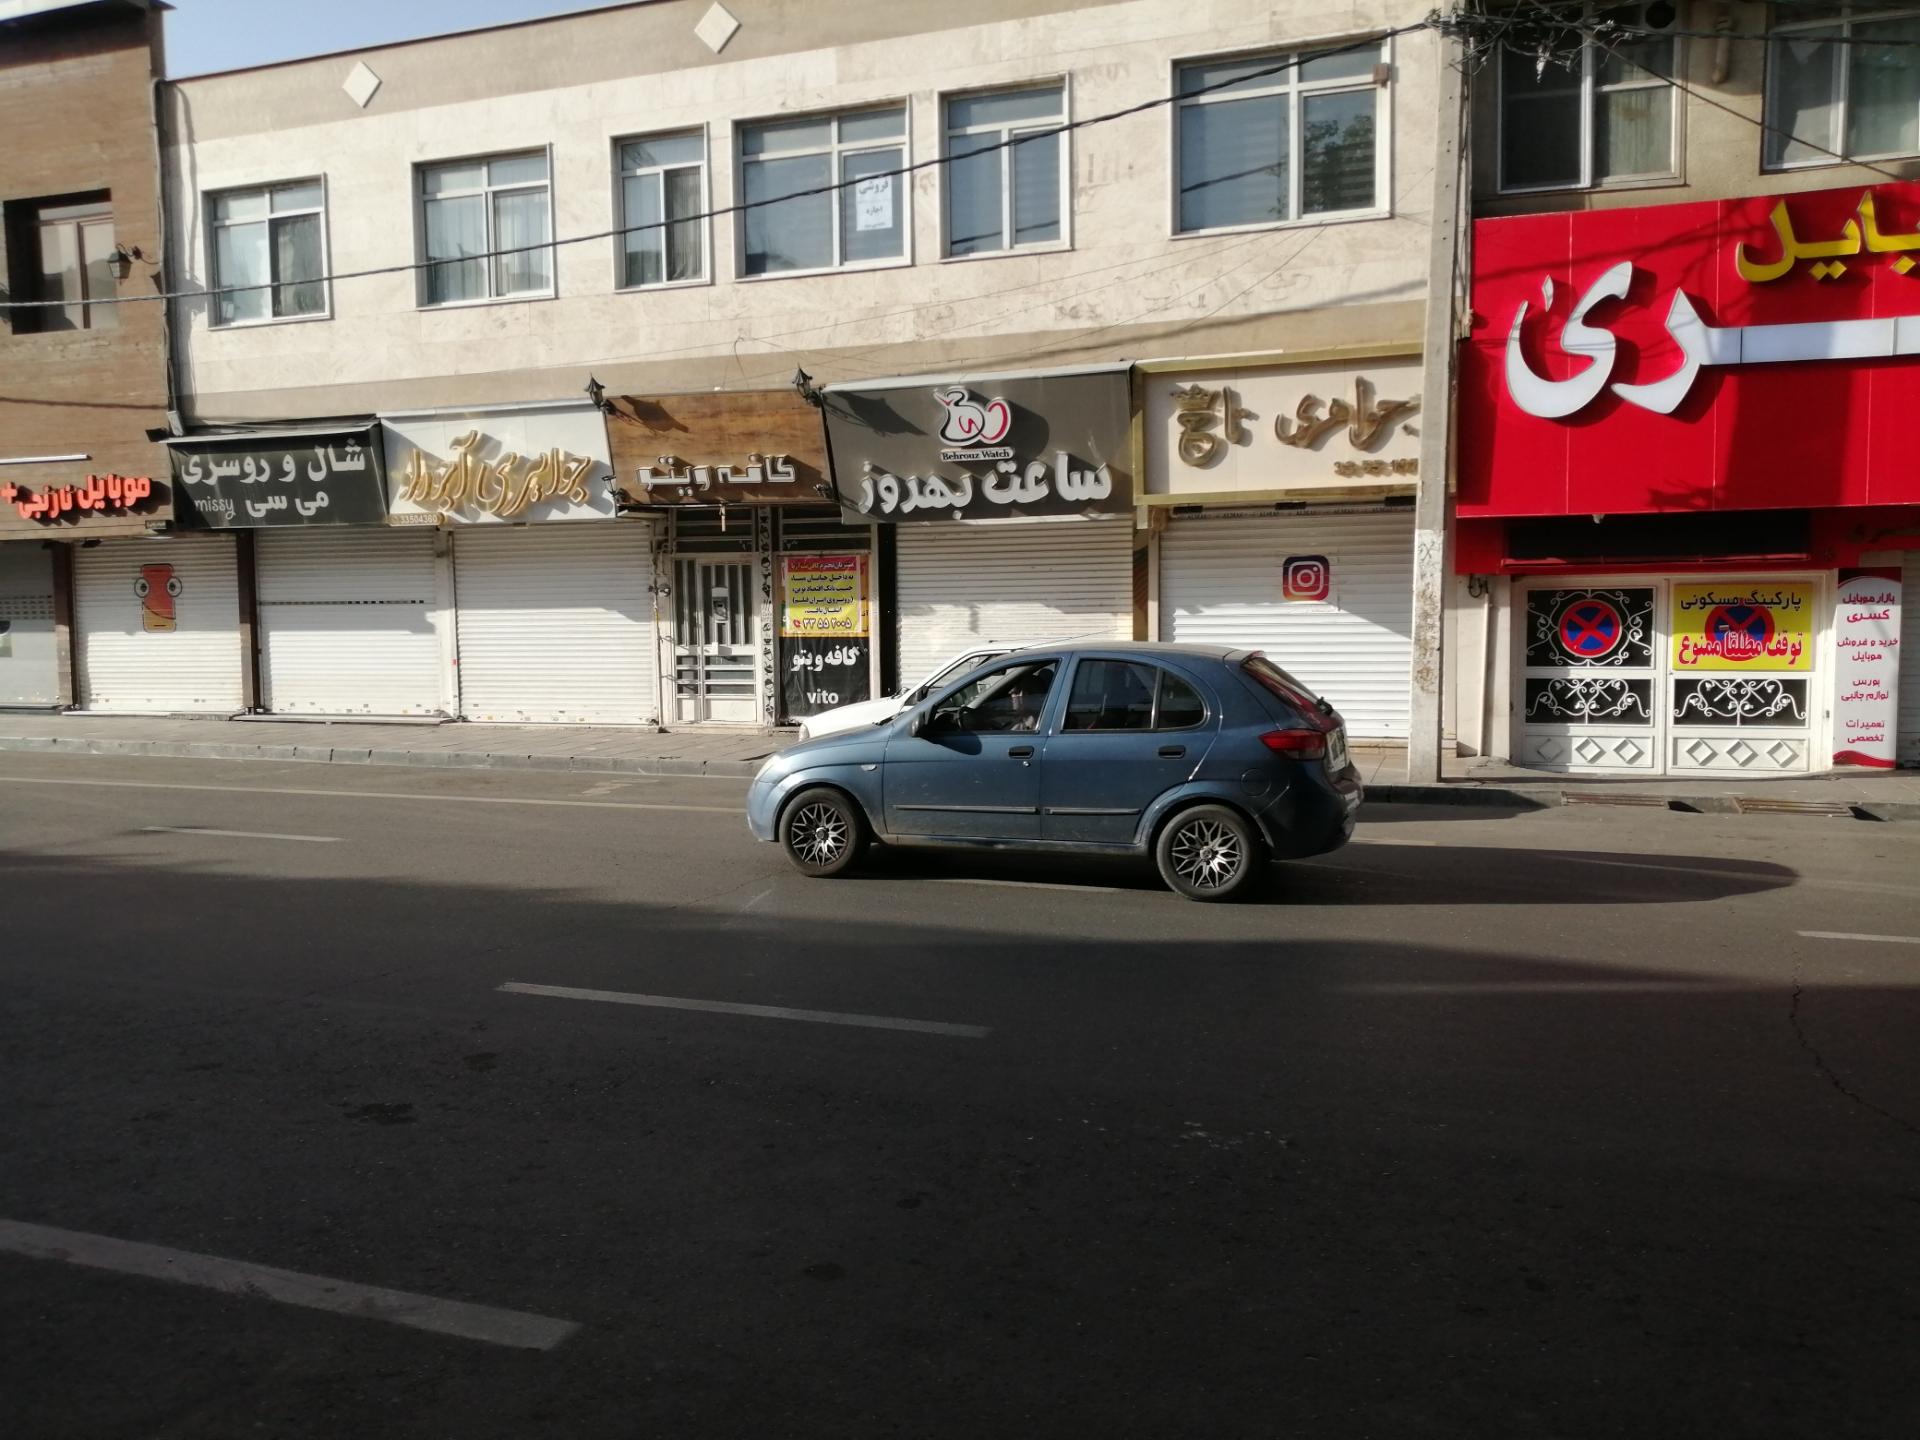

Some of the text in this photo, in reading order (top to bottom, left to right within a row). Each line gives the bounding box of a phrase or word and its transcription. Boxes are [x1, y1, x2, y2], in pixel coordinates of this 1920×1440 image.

[181, 437, 366, 486] شال و روسری
[942, 449, 1010, 461] Behrouz Watch
[636, 452, 796, 497] کافه ویتو
[77, 474, 151, 510] موبایل
[858, 450, 1112, 520] ساعت بهروز
[18, 484, 75, 519] نارنجی
[194, 495, 236, 520] missy
[246, 490, 330, 518] می سی
[1680, 590, 1802, 611] پارکینگ مسکونی
[1842, 591, 1895, 605] بازار موبایل
[817, 617, 830, 629] ۵۵
[831, 617, 852, 630] ۲۰۰۵
[1846, 608, 1890, 623] کسری
[1678, 635, 1721, 665] ممنوع
[1766, 630, 1803, 665] توقف
[1837, 637, 1868, 648] فروش
[1879, 638, 1898, 647] خرید
[790, 645, 860, 672] کافه ویتو
[1852, 651, 1882, 662] موبایل
[1853, 679, 1880, 687] بورس
[807, 687, 839, 705] vito
[1841, 690, 1889, 702] لوازم جانبی
[1846, 719, 1885, 730] تعمیرات
[1847, 734, 1885, 744] تخصصی
